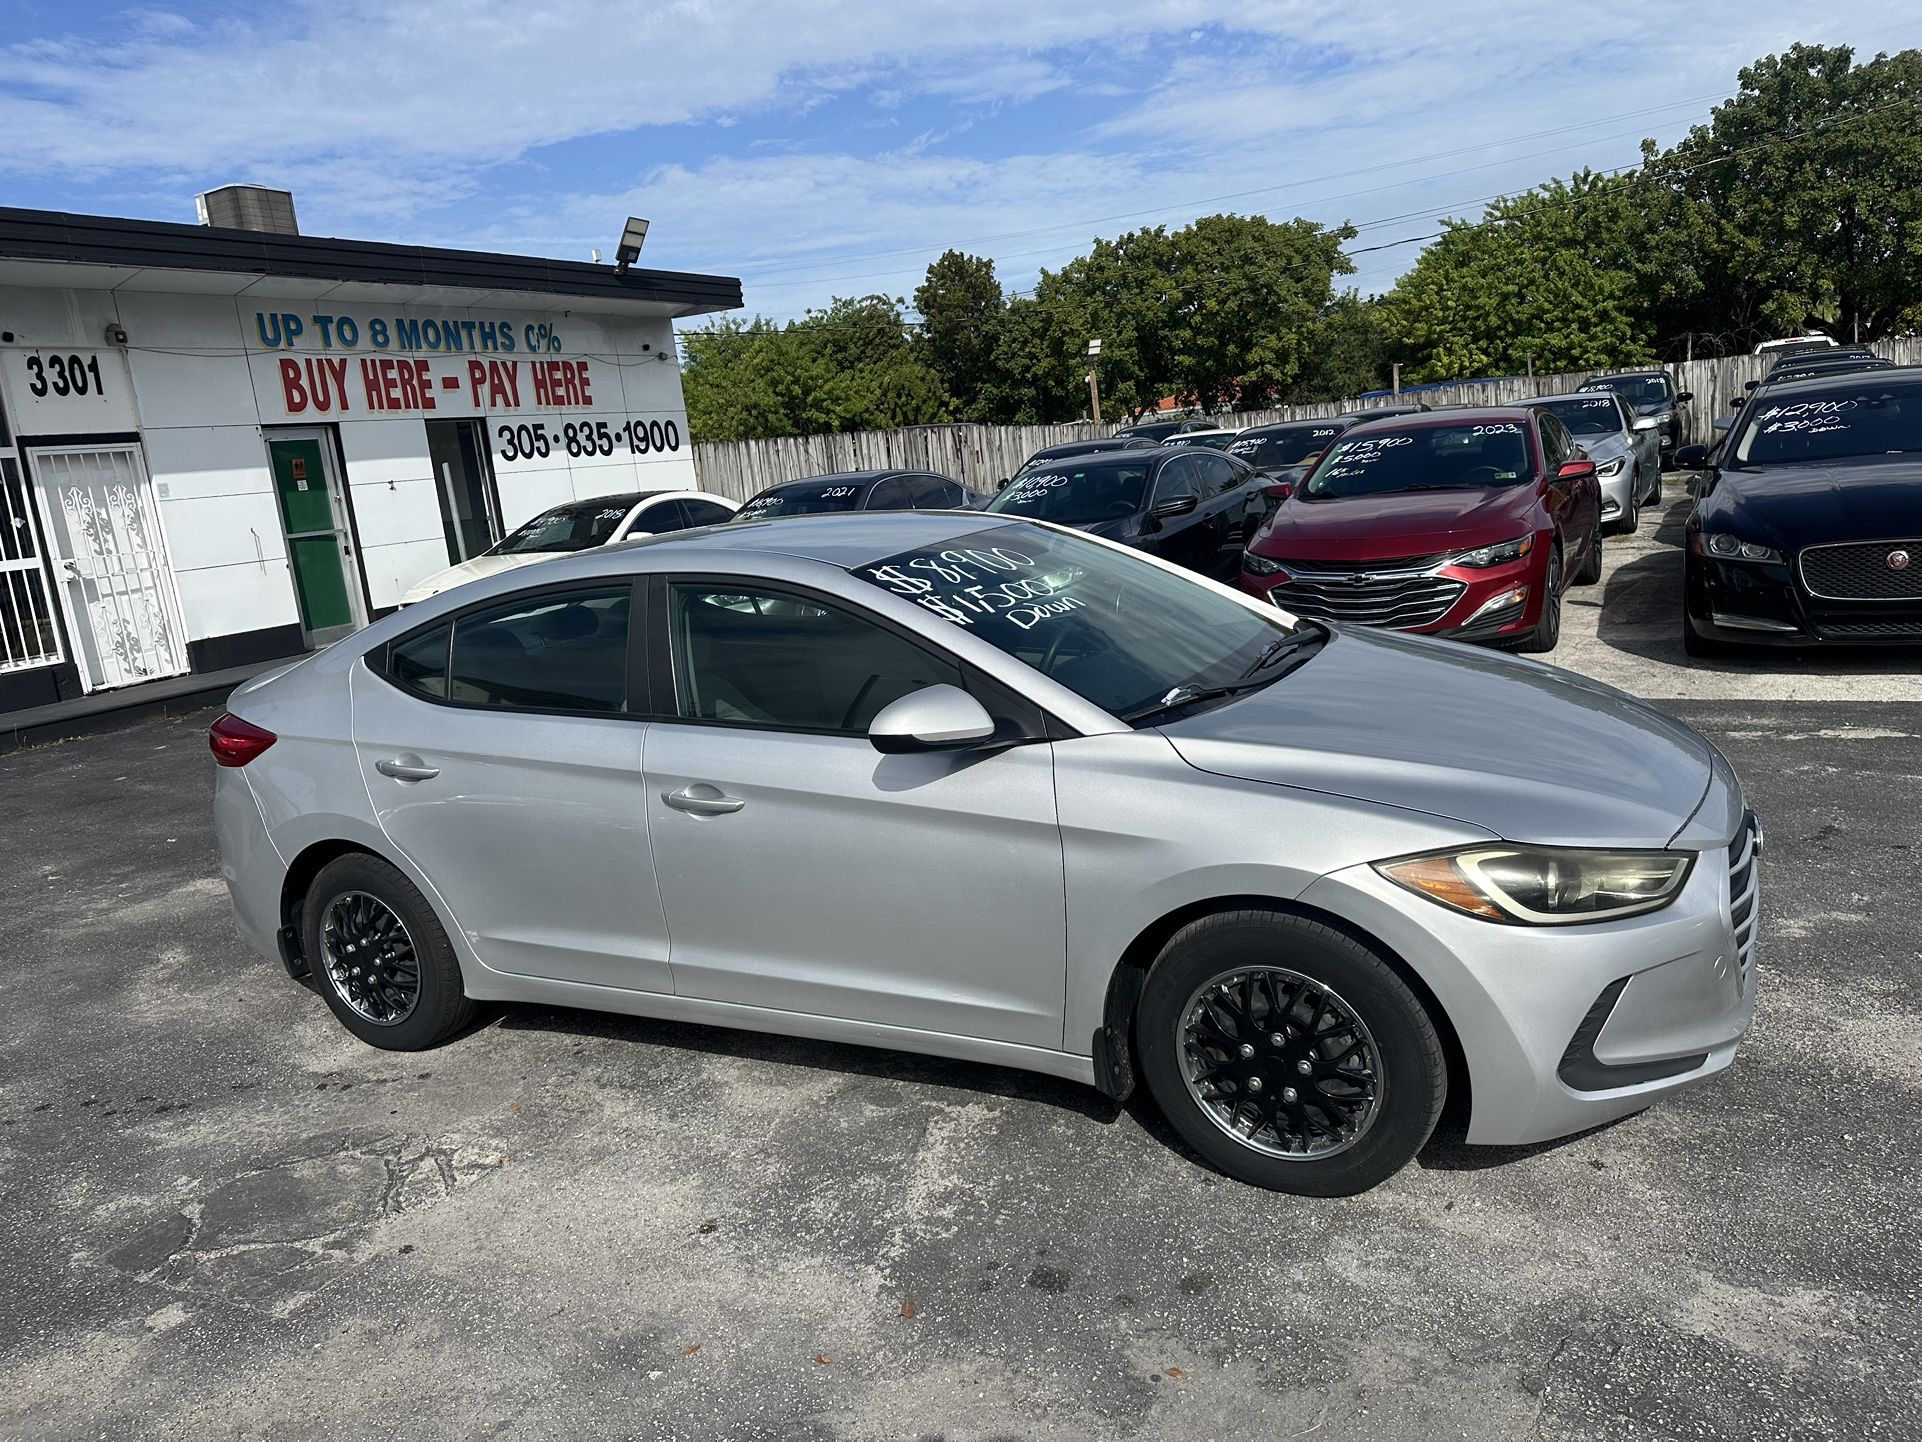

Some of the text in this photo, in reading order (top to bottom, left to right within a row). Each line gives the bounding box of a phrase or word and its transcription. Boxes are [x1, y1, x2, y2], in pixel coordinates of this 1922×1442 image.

[256, 312, 303, 348] UP
[312, 315, 359, 349] TO
[368, 318, 390, 349] 8
[395, 319, 516, 352] MONTHS
[27, 354, 104, 397] 3301
[278, 358, 349, 413] BUY
[359, 358, 437, 411] HERE
[466, 360, 521, 409] PAY
[530, 360, 593, 407] HERE
[1582, 399, 1611, 409] 2018
[1758, 400, 1858, 421] $12,900
[1312, 428, 1336, 438] 2012
[1472, 423, 1518, 436] 2023
[1763, 415, 1841, 434] $3,000
[821, 486, 856, 498] 2021
[1005, 596, 1086, 630] Down
